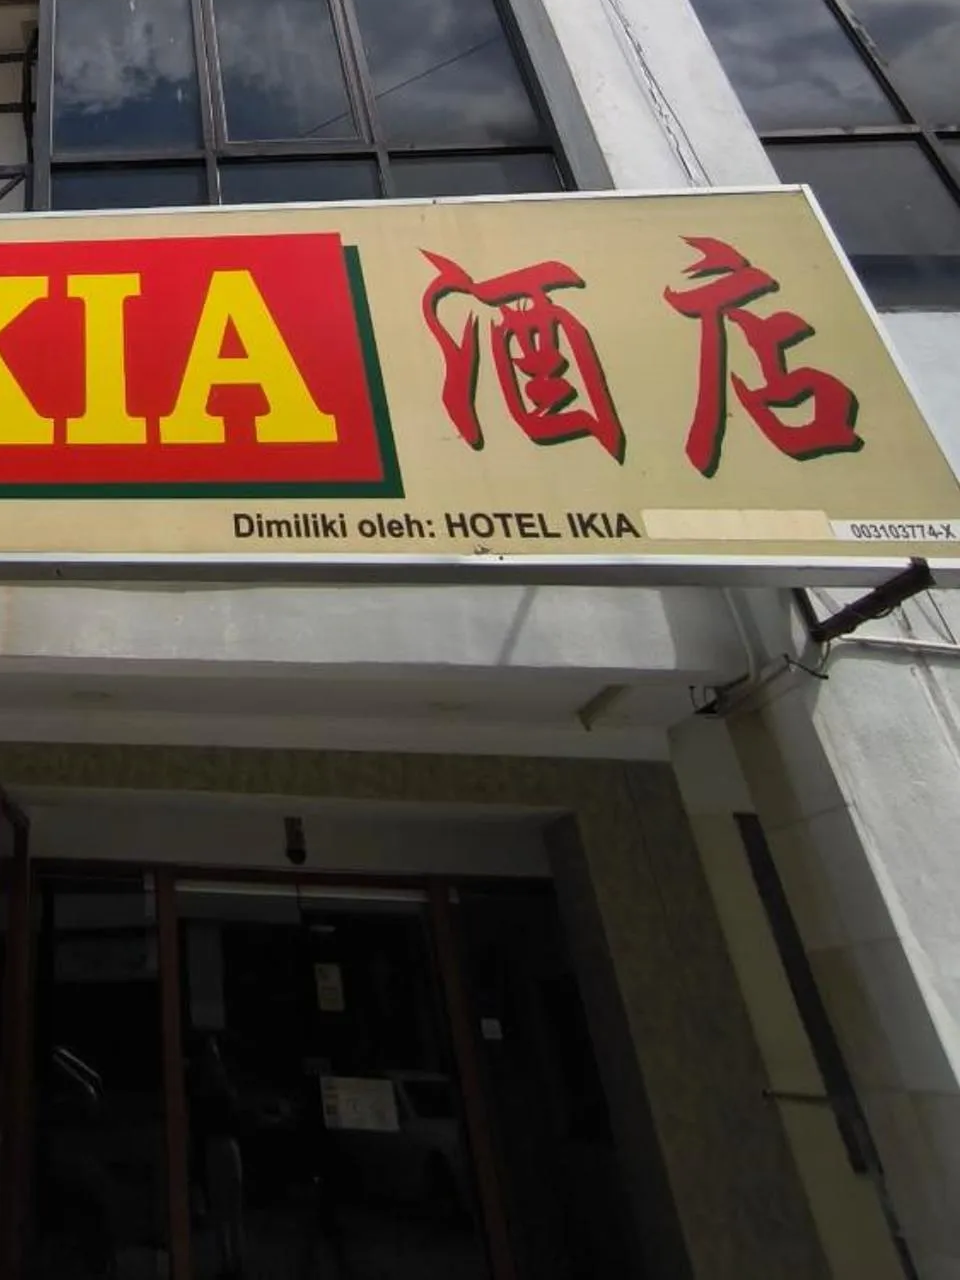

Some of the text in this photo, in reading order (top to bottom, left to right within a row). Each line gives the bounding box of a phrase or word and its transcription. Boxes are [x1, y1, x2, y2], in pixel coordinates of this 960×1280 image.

[418, 235, 865, 479] 酒店
[233, 512, 957, 539] Dimiliki oleh: HOTEL IKIA 003103774-X
